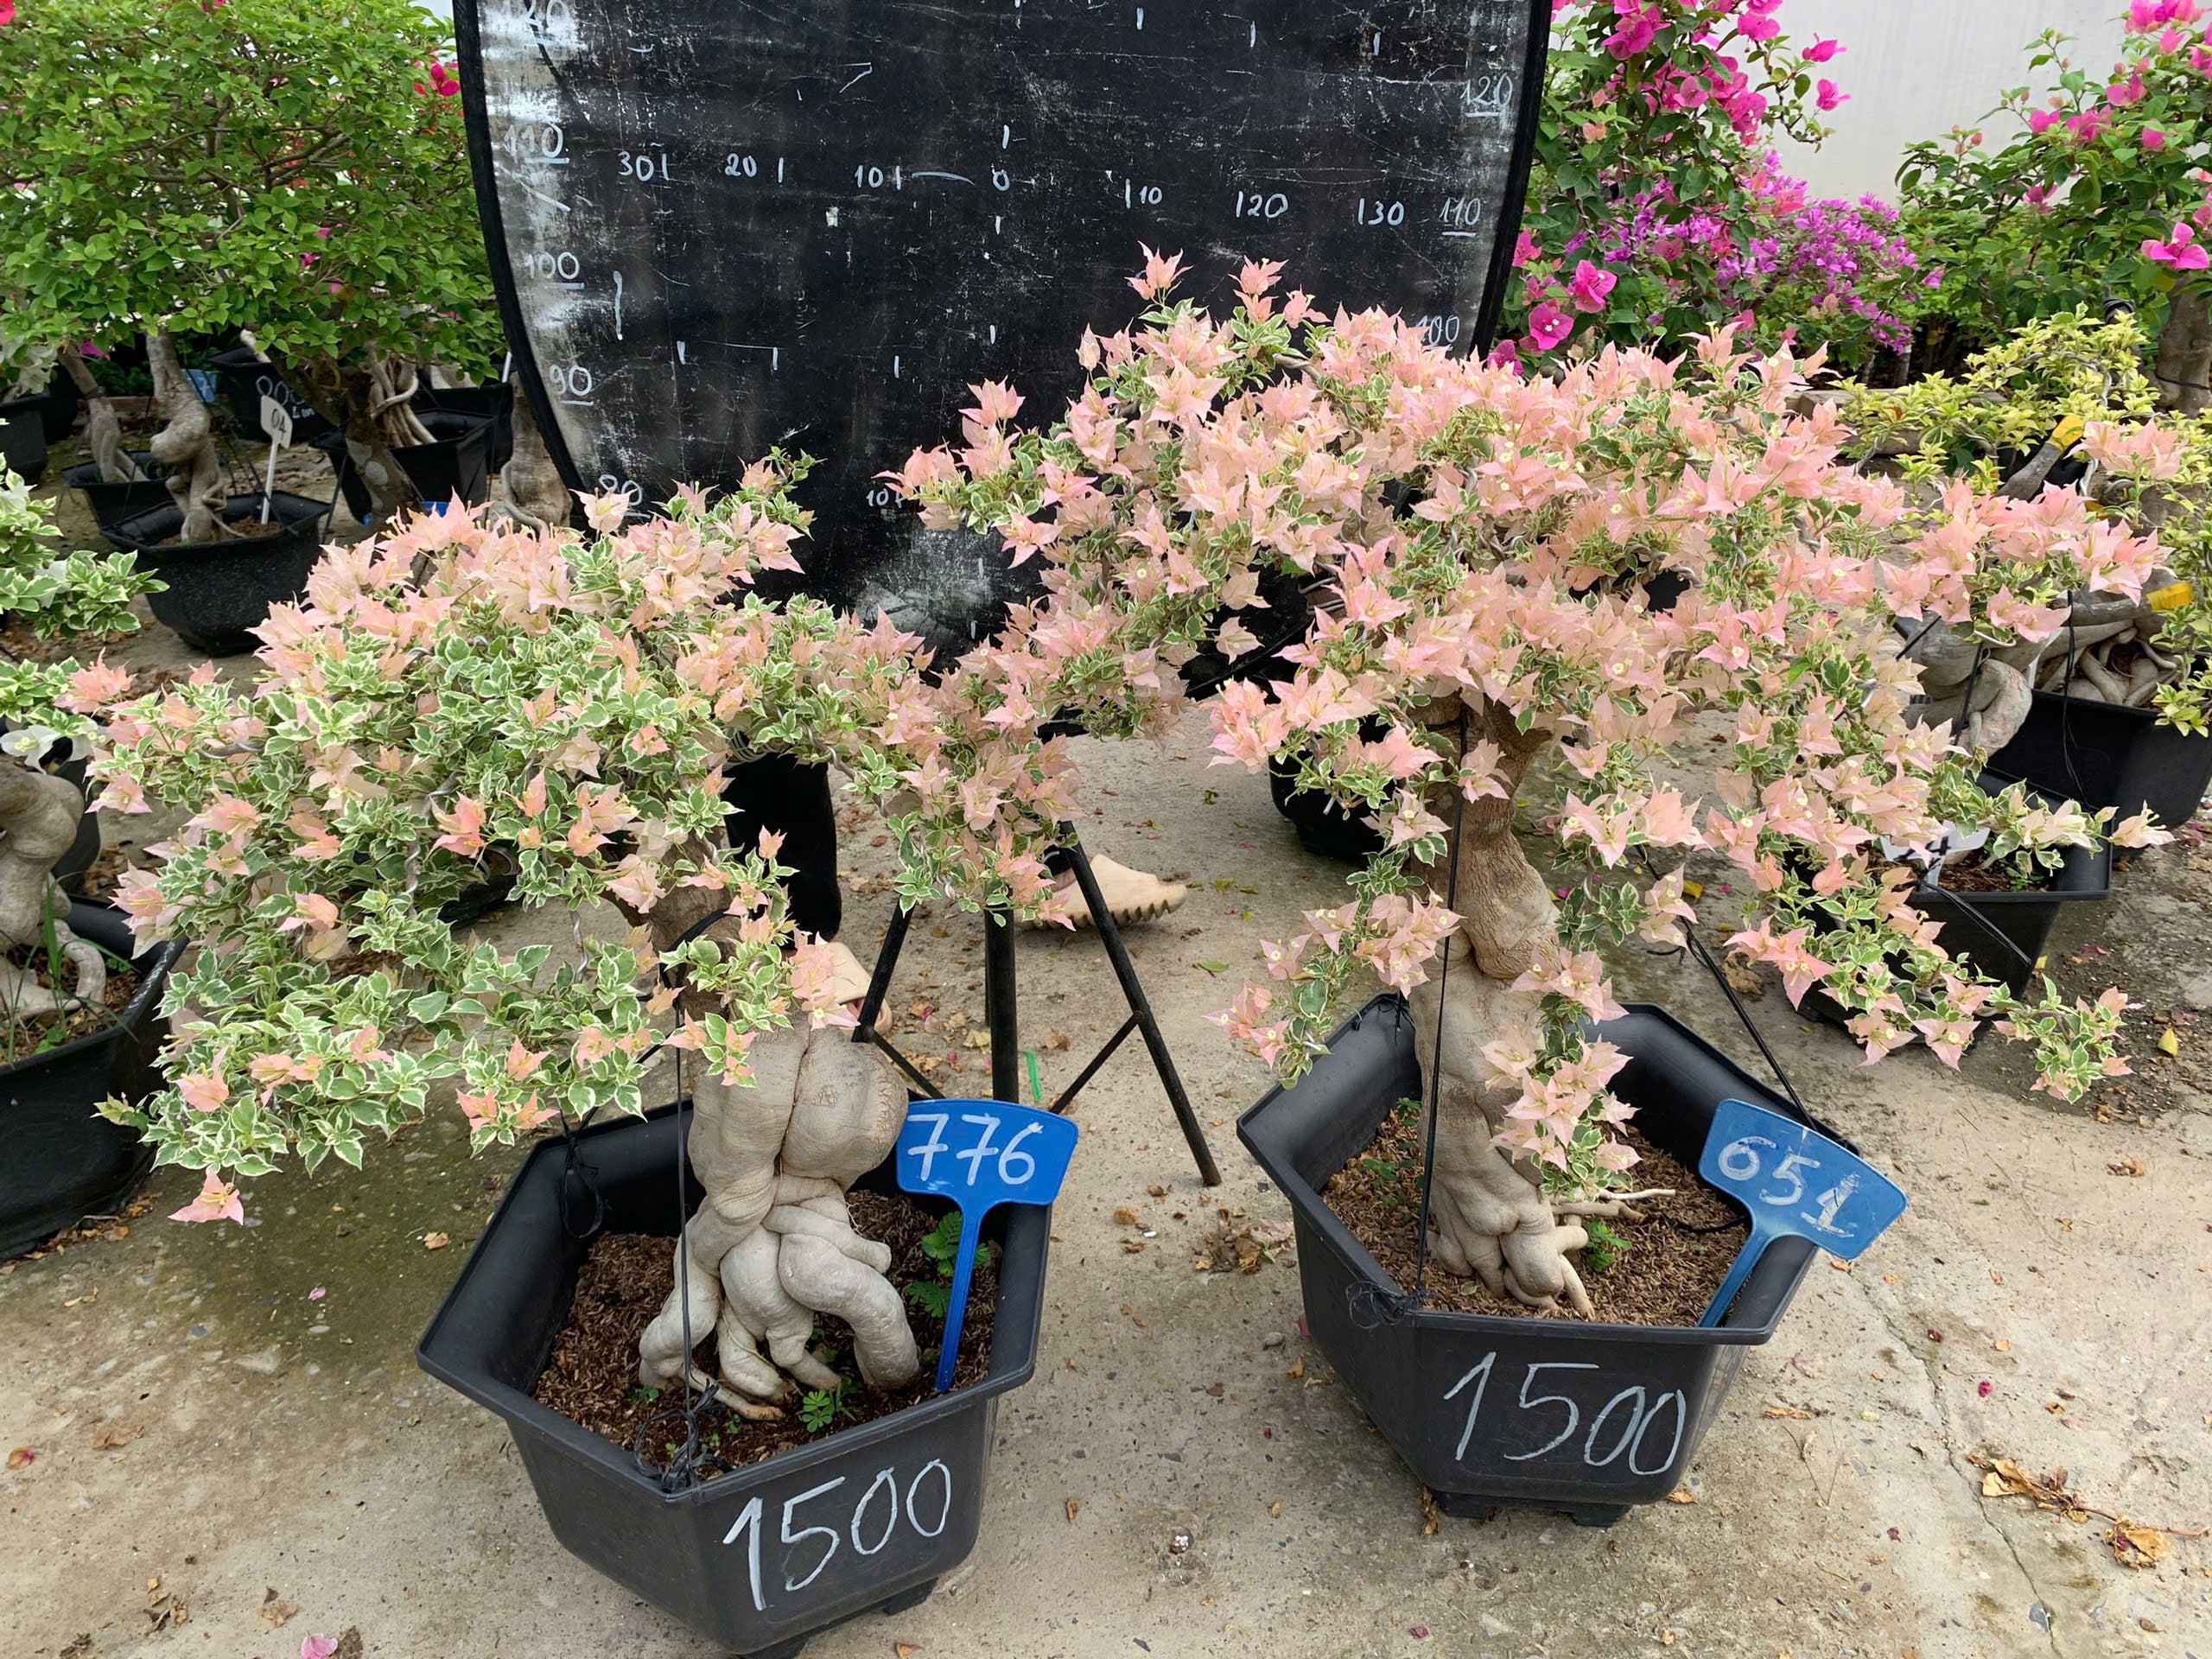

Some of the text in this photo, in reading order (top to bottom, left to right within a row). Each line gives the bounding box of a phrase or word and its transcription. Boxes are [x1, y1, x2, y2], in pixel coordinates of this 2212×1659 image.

[1460, 73, 1513, 106] 120
[725, 153, 757, 178] 20
[1439, 196, 1481, 226] 110
[524, 251, 581, 280] 100
[550, 364, 593, 396] 90
[271, 408, 287, 441] 04
[907, 1113, 1044, 1186] 776
[1718, 1135, 1860, 1238] 651
[1443, 1351, 1687, 1475] 1500
[722, 1459, 951, 1611] 1500
